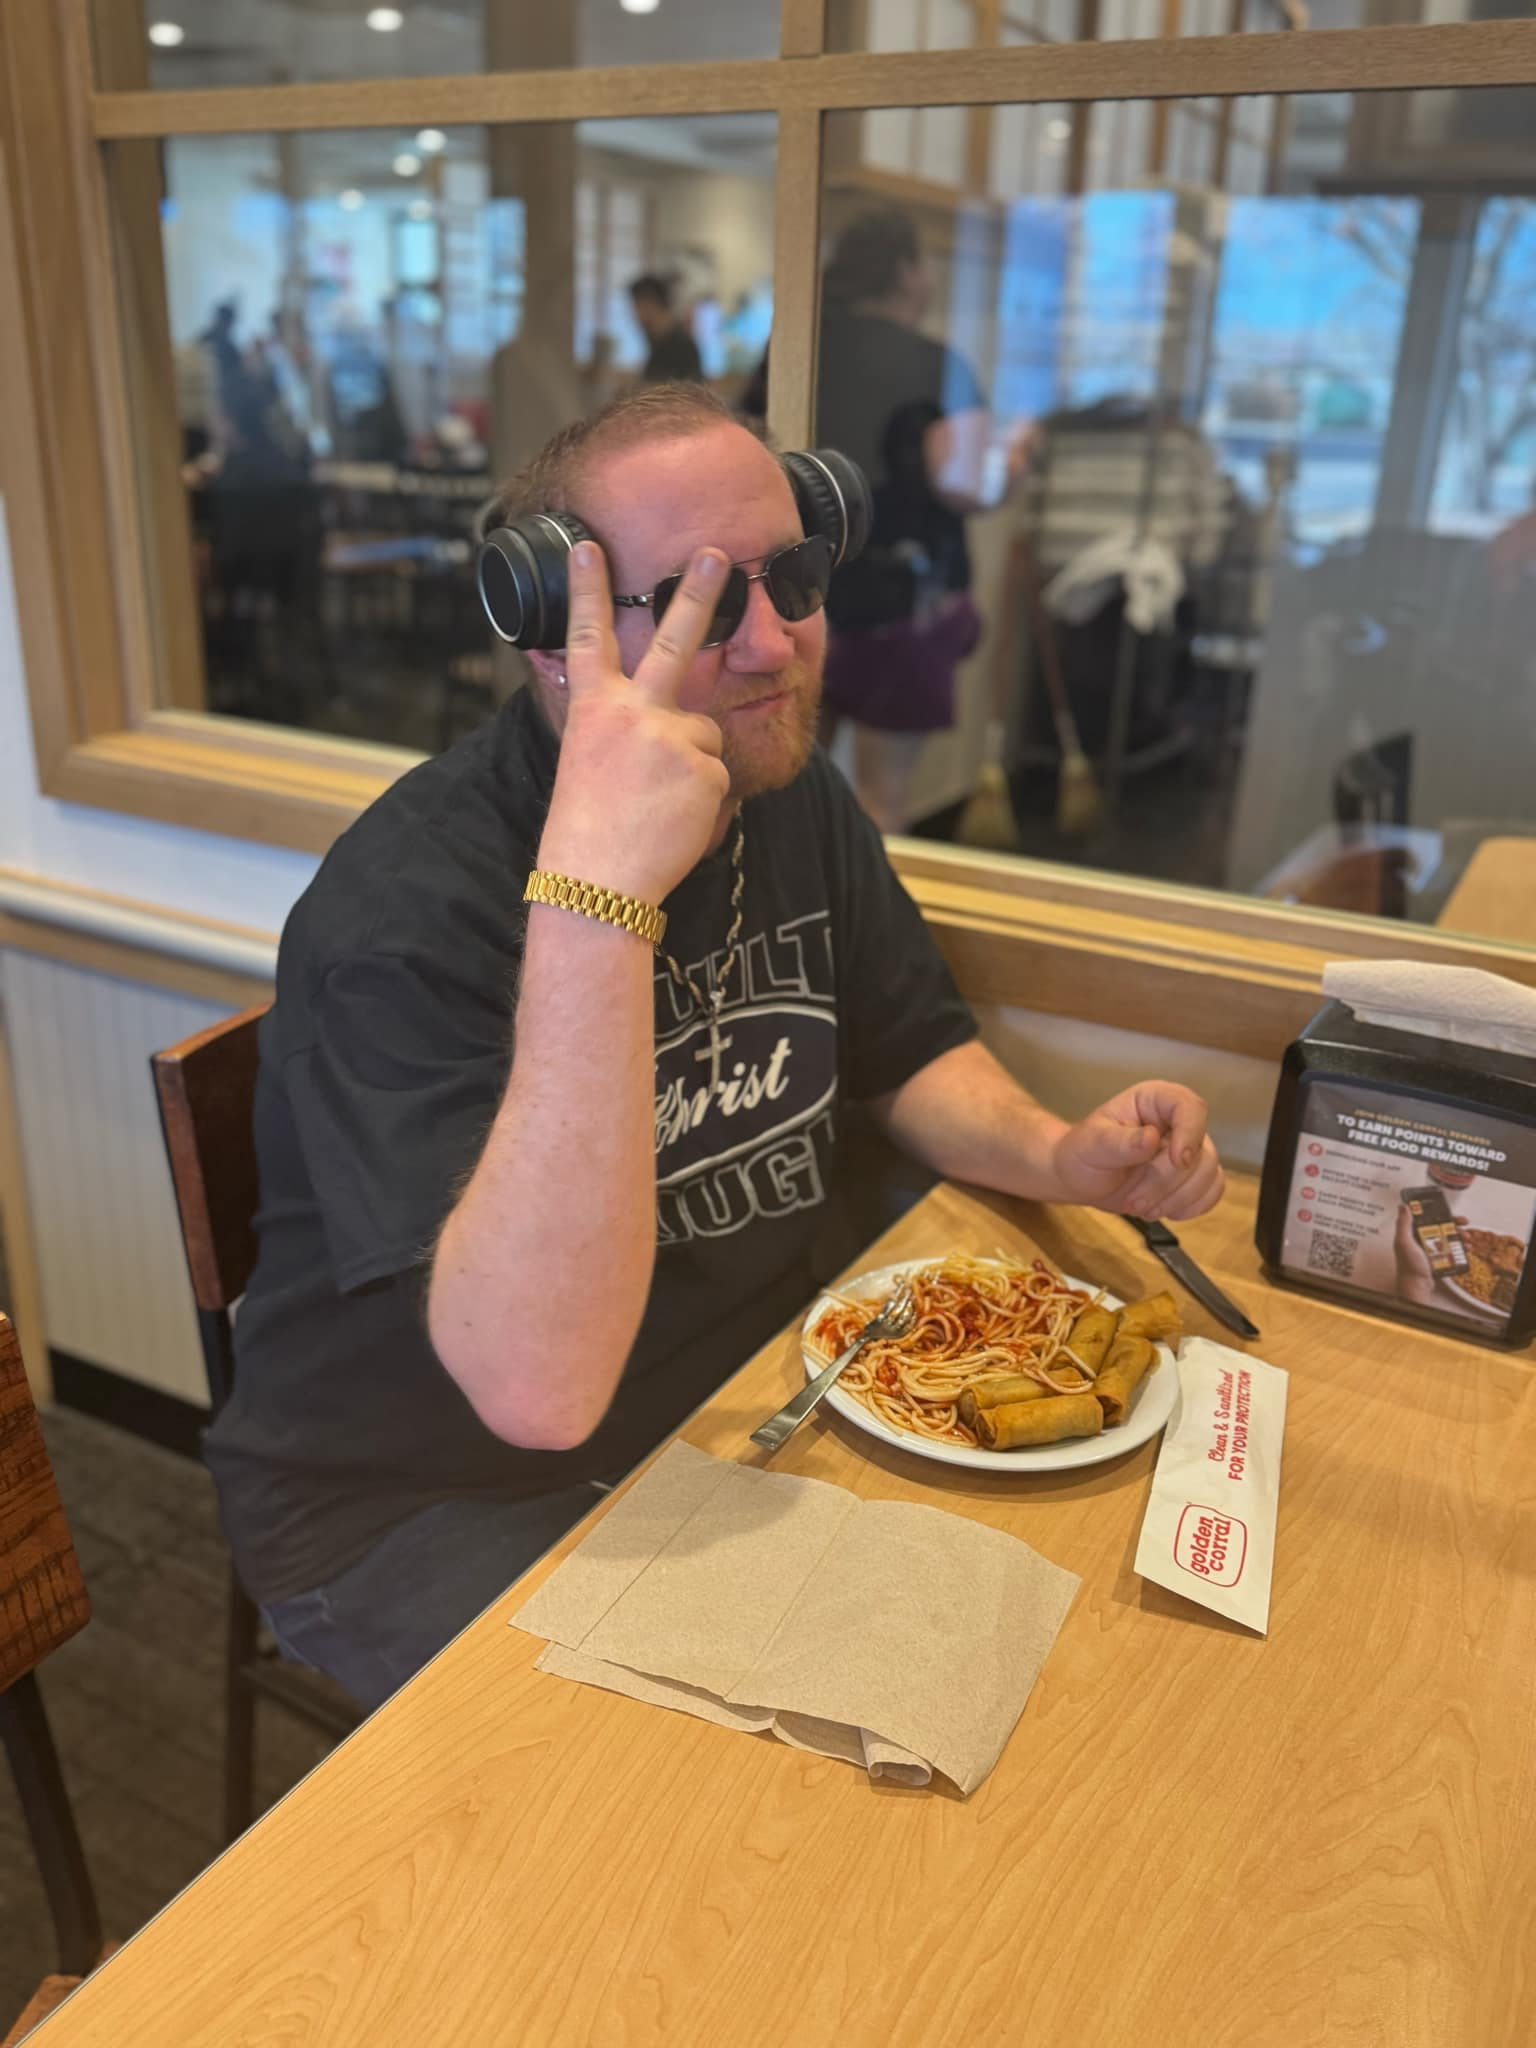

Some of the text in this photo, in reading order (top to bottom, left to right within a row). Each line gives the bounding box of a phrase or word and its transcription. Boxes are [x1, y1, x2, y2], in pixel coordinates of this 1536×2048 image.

[654, 909, 837, 1039] UILT
[1336, 1113, 1506, 1162] TO EARN POINTS TOWARD
[1347, 1129, 1379, 1145] FREE
[1381, 1136, 1419, 1155] FOOD
[1421, 1146, 1490, 1171] REWARDS!
[1208, 1368, 1233, 1461] Clean & Sanitized
[1227, 1369, 1251, 1481] FOR YOUR PROTECTION
[1190, 1516, 1214, 1575] golden
[1209, 1516, 1231, 1572] corral
